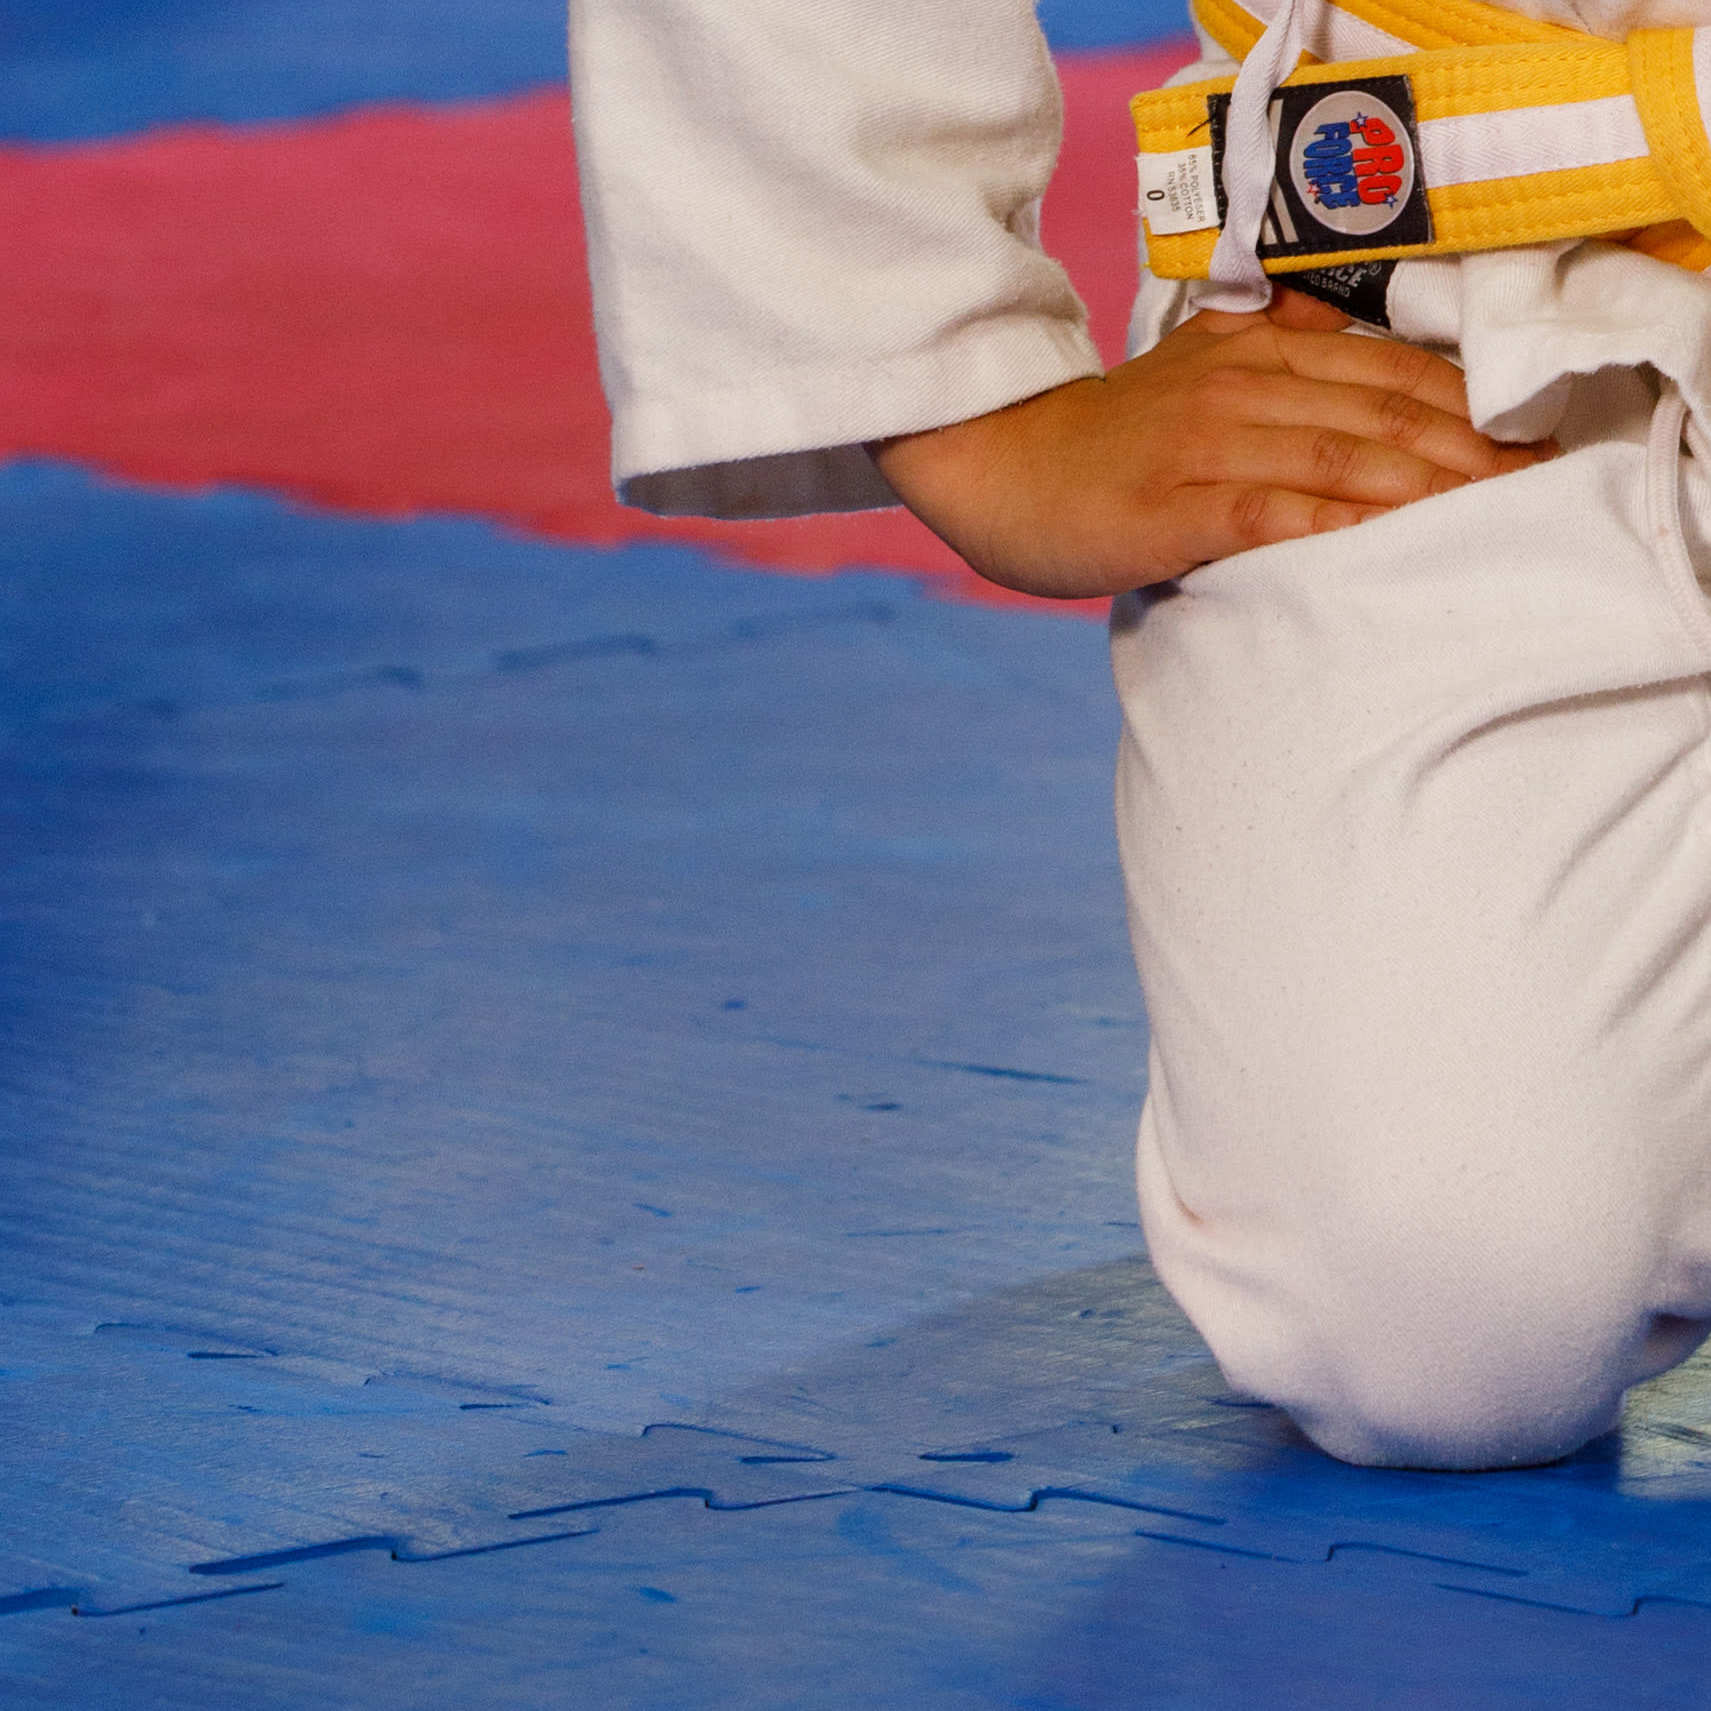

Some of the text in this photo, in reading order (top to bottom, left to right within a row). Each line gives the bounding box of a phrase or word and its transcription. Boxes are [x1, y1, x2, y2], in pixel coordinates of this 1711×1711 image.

[1180, 182, 1194, 220] COTTON
[1303, 121, 1361, 211] FORCE
[1350, 116, 1405, 206] PRO
